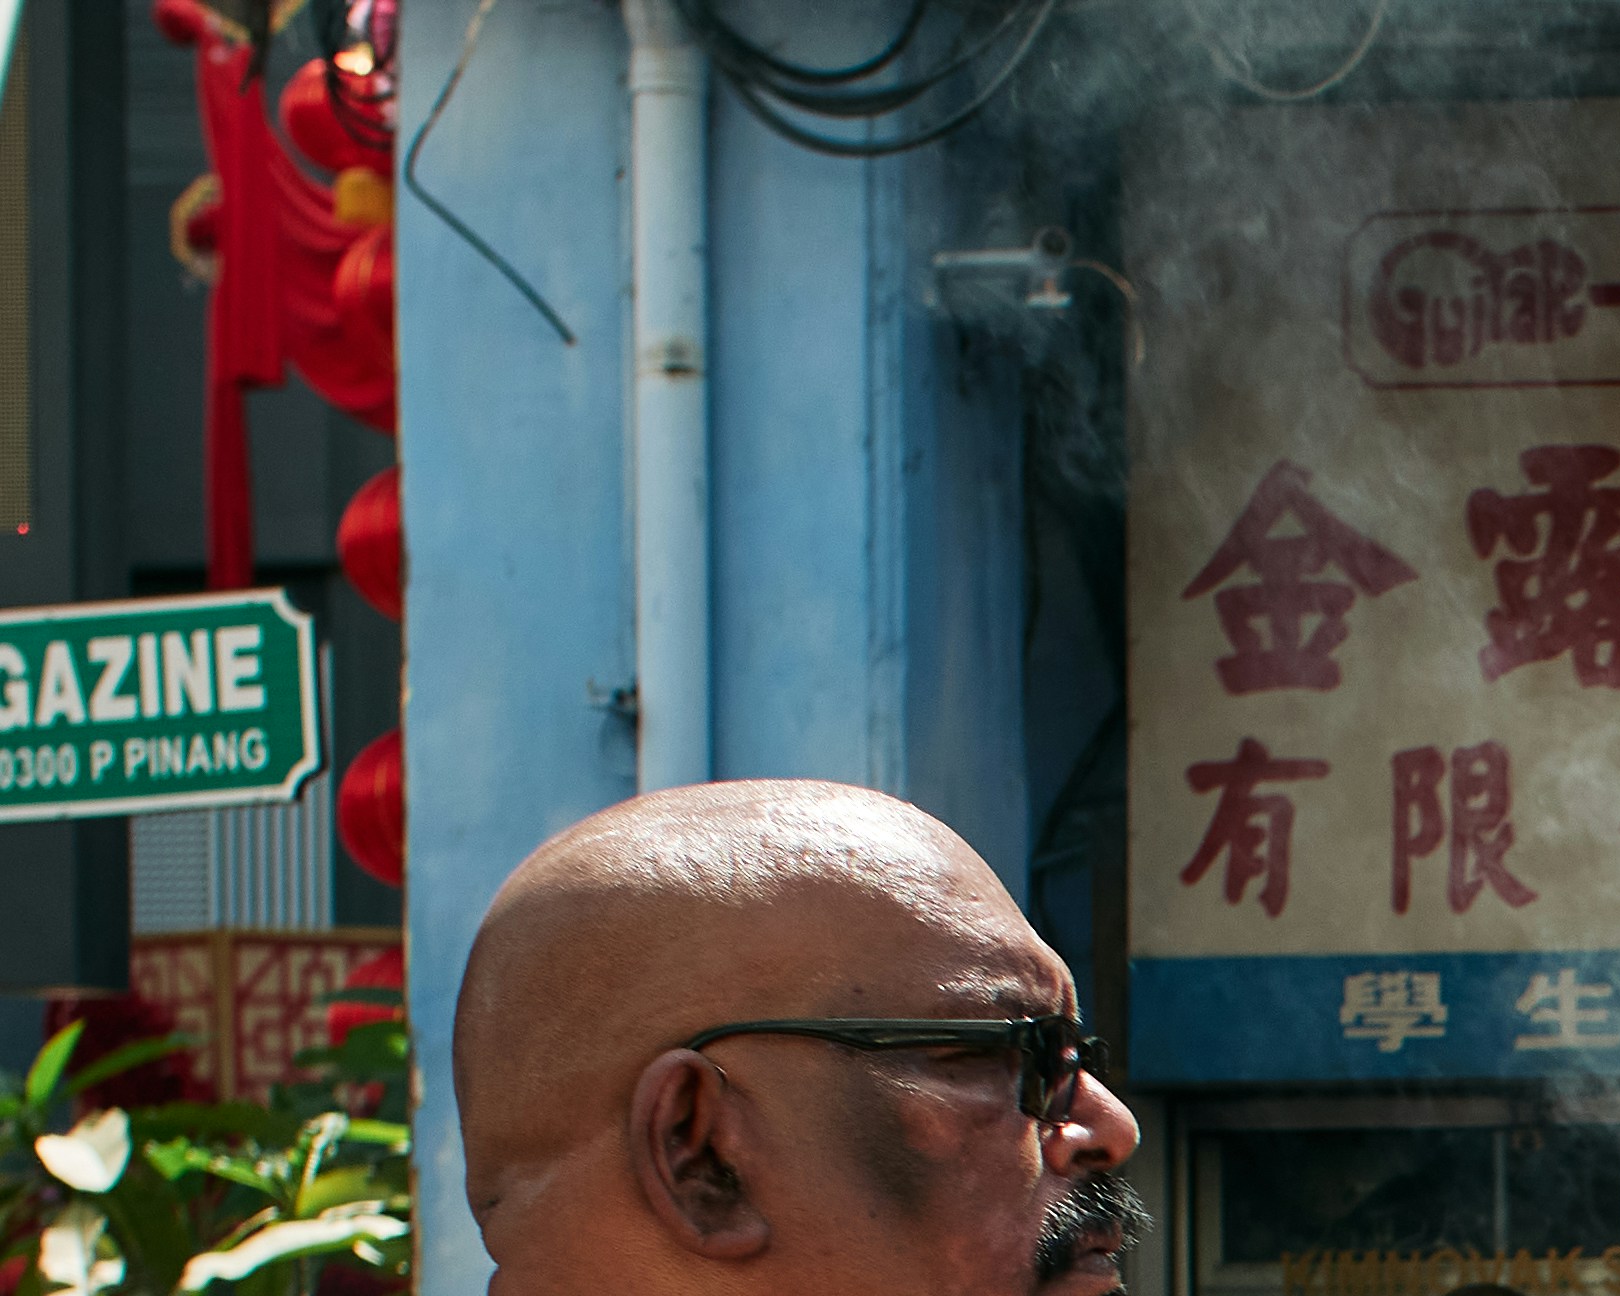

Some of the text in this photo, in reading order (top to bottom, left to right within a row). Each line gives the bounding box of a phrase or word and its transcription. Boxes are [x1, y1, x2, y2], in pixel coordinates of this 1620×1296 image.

[90, 740, 116, 782] P
[124, 728, 269, 780] PINANG
[1281, 1246, 1584, 1296] KIMNOVAK
